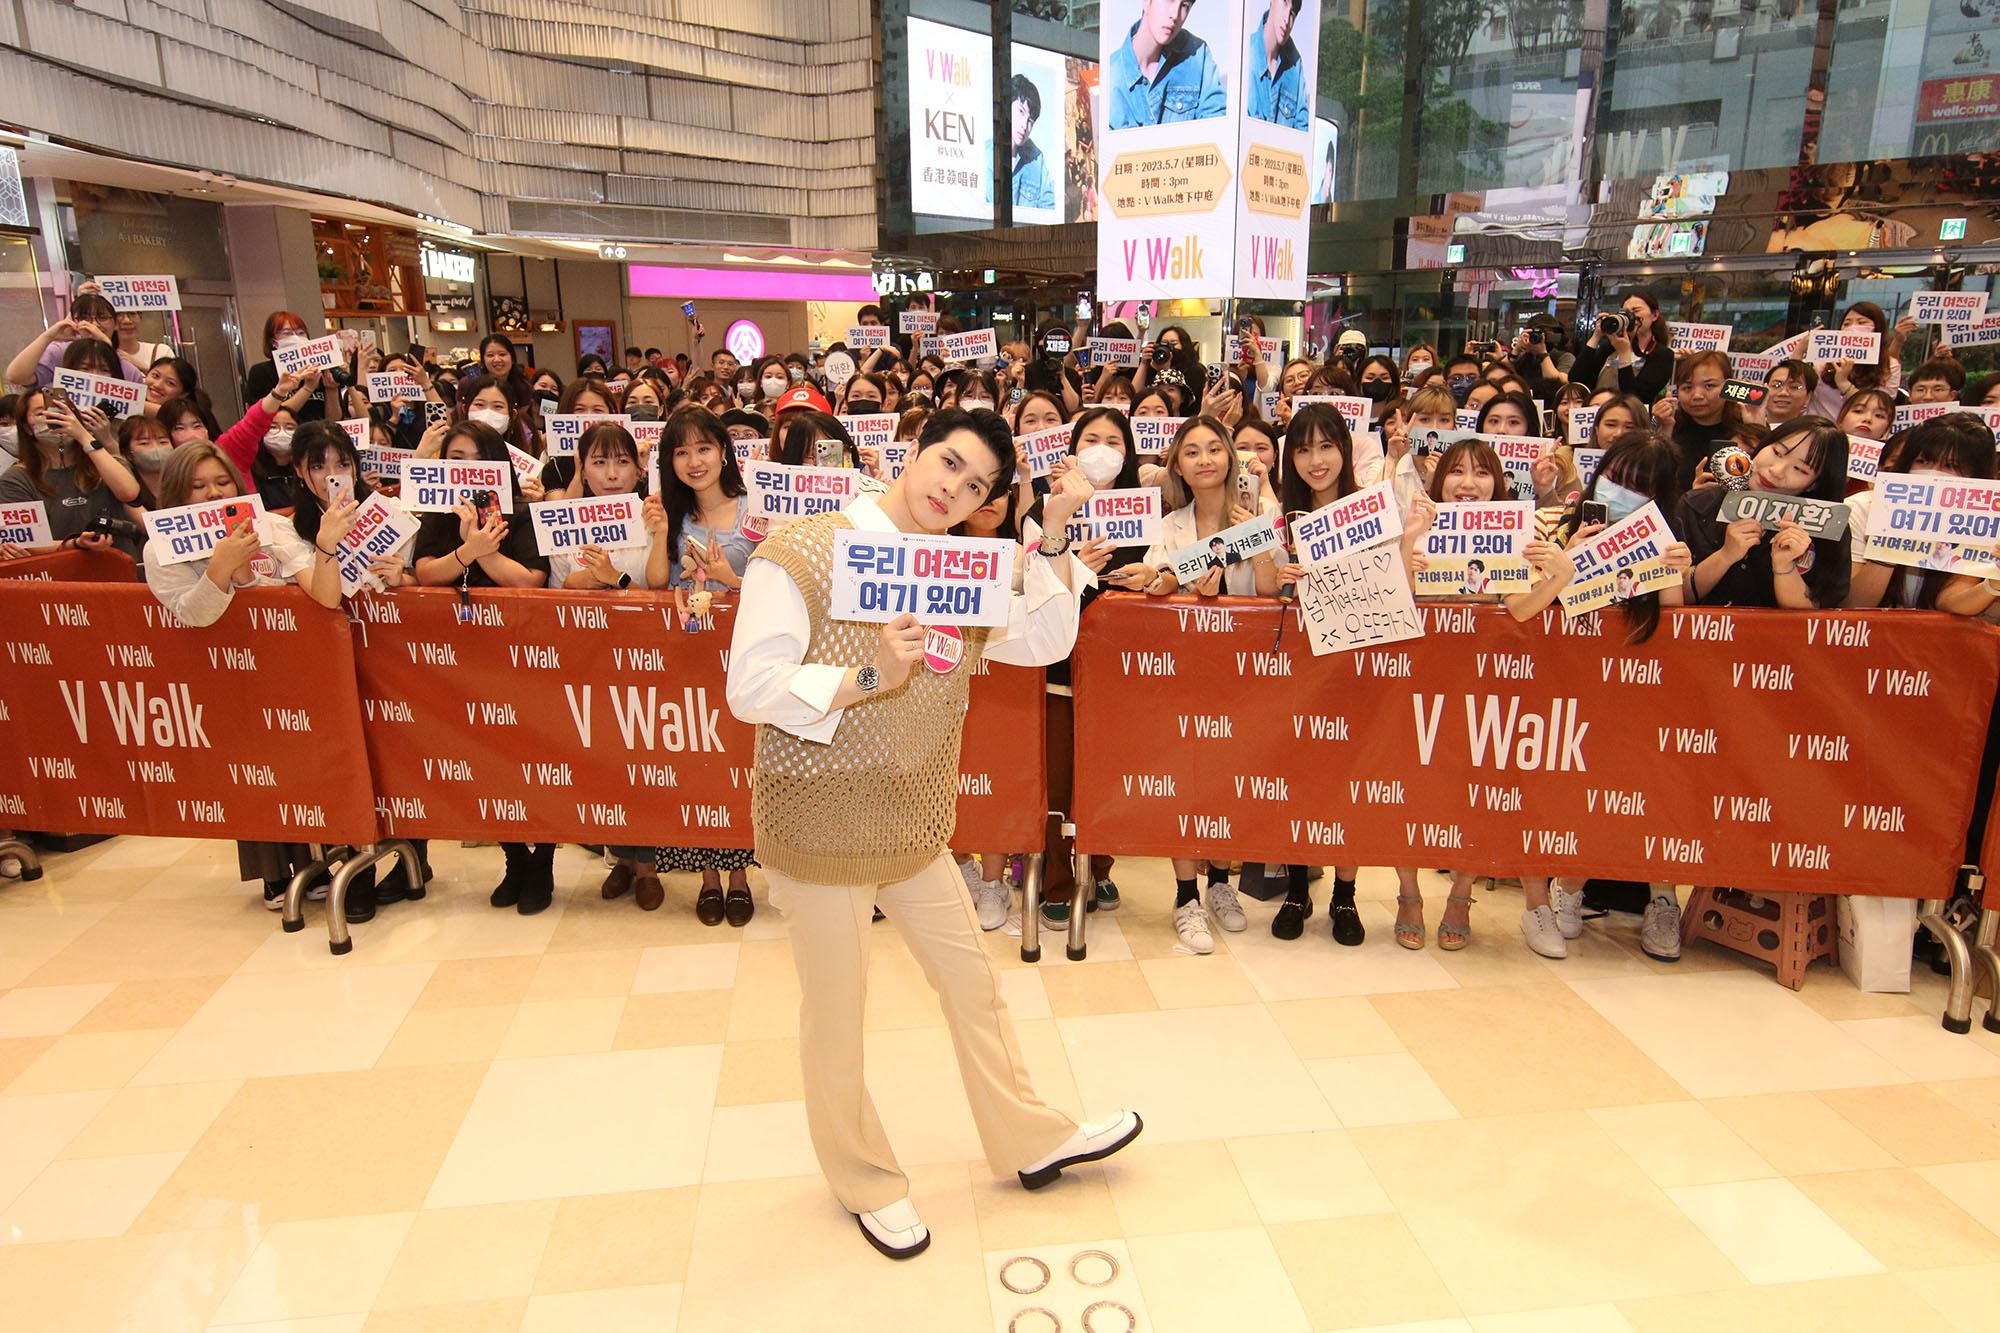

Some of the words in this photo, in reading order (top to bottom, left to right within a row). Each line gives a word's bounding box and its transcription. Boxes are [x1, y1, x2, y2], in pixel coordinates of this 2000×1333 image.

[926, 48, 935, 81] V
[940, 51, 971, 87] Walk
[1942, 79, 1993, 103] 惠康
[1932, 103, 1998, 117] wellcome
[925, 108, 974, 145] KEN
[1123, 239, 1137, 281] V
[1146, 235, 1204, 281] Walk
[1252, 235, 1260, 279] V
[1264, 235, 1293, 281] Walk
[102, 281, 129, 293] 우리
[132, 280, 170, 292] 여전히
[112, 295, 138, 307] 여기
[142, 295, 167, 306] 있어
[1916, 297, 1939, 307] 우리
[1943, 297, 1981, 308] 여전히
[902, 315, 915, 323] 우리
[1919, 309, 1943, 320] 여기
[1946, 309, 1972, 320] 있어
[853, 338, 867, 346] 여기
[869, 338, 883, 346] 있어
[865, 329, 886, 337] 여전히
[946, 339, 963, 347] 우리
[965, 334, 991, 344] 여전히
[1669, 327, 1688, 338] 우리
[1692, 328, 1724, 340] 여전히
[1815, 335, 1837, 345] 우리
[1841, 337, 1874, 348] 여전히
[1952, 333, 1975, 344] 여기
[279, 349, 299, 363] 우리
[301, 340, 334, 357] 여전히
[951, 349, 969, 358] 여기
[972, 347, 988, 356] 있어
[1090, 342, 1108, 352] 우리
[1110, 342, 1136, 352] 여전히
[1818, 347, 1841, 358] 여기
[1094, 353, 1111, 363] 여기
[829, 363, 850, 375] 재환
[61, 375, 90, 392] 우리
[95, 381, 138, 401] 여전히
[372, 377, 391, 387] 우리
[1725, 384, 1749, 398] 재환
[378, 388, 397, 398] 여기
[401, 388, 420, 397] 있어
[552, 420, 579, 434] 우리
[857, 420, 893, 431] 여전히
[1136, 423, 1160, 435] 우리
[410, 467, 445, 485] 우리
[450, 468, 502, 486] 여전히
[756, 471, 790, 491] 우리
[795, 474, 849, 495] 여전히
[419, 488, 454, 505] 여기
[764, 494, 798, 515] 여기
[1884, 482, 1935, 507] 우리
[540, 508, 575, 526] 우리
[578, 502, 632, 524] 여전히
[1095, 496, 1151, 517] 여전히
[1299, 515, 1329, 542] 우리
[1333, 491, 1386, 527] 여전히
[1737, 496, 1832, 531] 이재환
[155, 514, 196, 535] 우리
[344, 503, 389, 549] 여전히
[1462, 510, 1523, 530] 여전히
[1890, 509, 1940, 532] 여기
[368, 525, 401, 556] 있어
[552, 528, 586, 547] 여기
[591, 524, 627, 543] 있어
[1066, 523, 1100, 542] 여기
[1106, 520, 1143, 538] 있어
[1226, 527, 1275, 554] 지켜줄게
[1310, 533, 1343, 560] 여기
[1347, 516, 1382, 545] 있어
[1597, 514, 1657, 560] 여전히
[171, 532, 213, 555] 여기
[1428, 535, 1466, 554] 여기
[1473, 535, 1512, 554] 있어
[1872, 536, 1931, 554] 귀여워서
[847, 543, 905, 576] 우리
[913, 547, 1000, 581] 여전히
[1302, 560, 1369, 596] 재화나
[1418, 571, 1464, 583] 귀여워서
[1490, 569, 1528, 580] 미안해
[859, 581, 919, 613] 여기
[926, 584, 982, 615] 있어
[1567, 583, 1614, 606] 귀여워서
[41, 604, 49, 625] V
[55, 604, 90, 625] Walk
[408, 643, 416, 663] V
[421, 643, 457, 665] Walk
[927, 632, 937, 651] V
[936, 635, 959, 663] Walk
[59, 680, 87, 743] V
[100, 681, 211, 747] Walk
[564, 685, 591, 747] V
[609, 686, 725, 752] Walk
[1179, 716, 1188, 737] V
[1194, 716, 1232, 738] Walk
[1413, 694, 1444, 765] V
[1466, 695, 1589, 771] Walk
[1659, 728, 1669, 751] V
[1677, 728, 1717, 753] Walk
[424, 759, 432, 780] V
[438, 759, 473, 780] Walk
[178, 801, 185, 821] V
[192, 801, 225, 822] Walk
[577, 804, 585, 824] V
[591, 804, 627, 825] Walk
[1291, 820, 1300, 842] V
[1307, 821, 1344, 845] Walk
[1772, 843, 1781, 866] V
[1789, 844, 1830, 869] Walk
